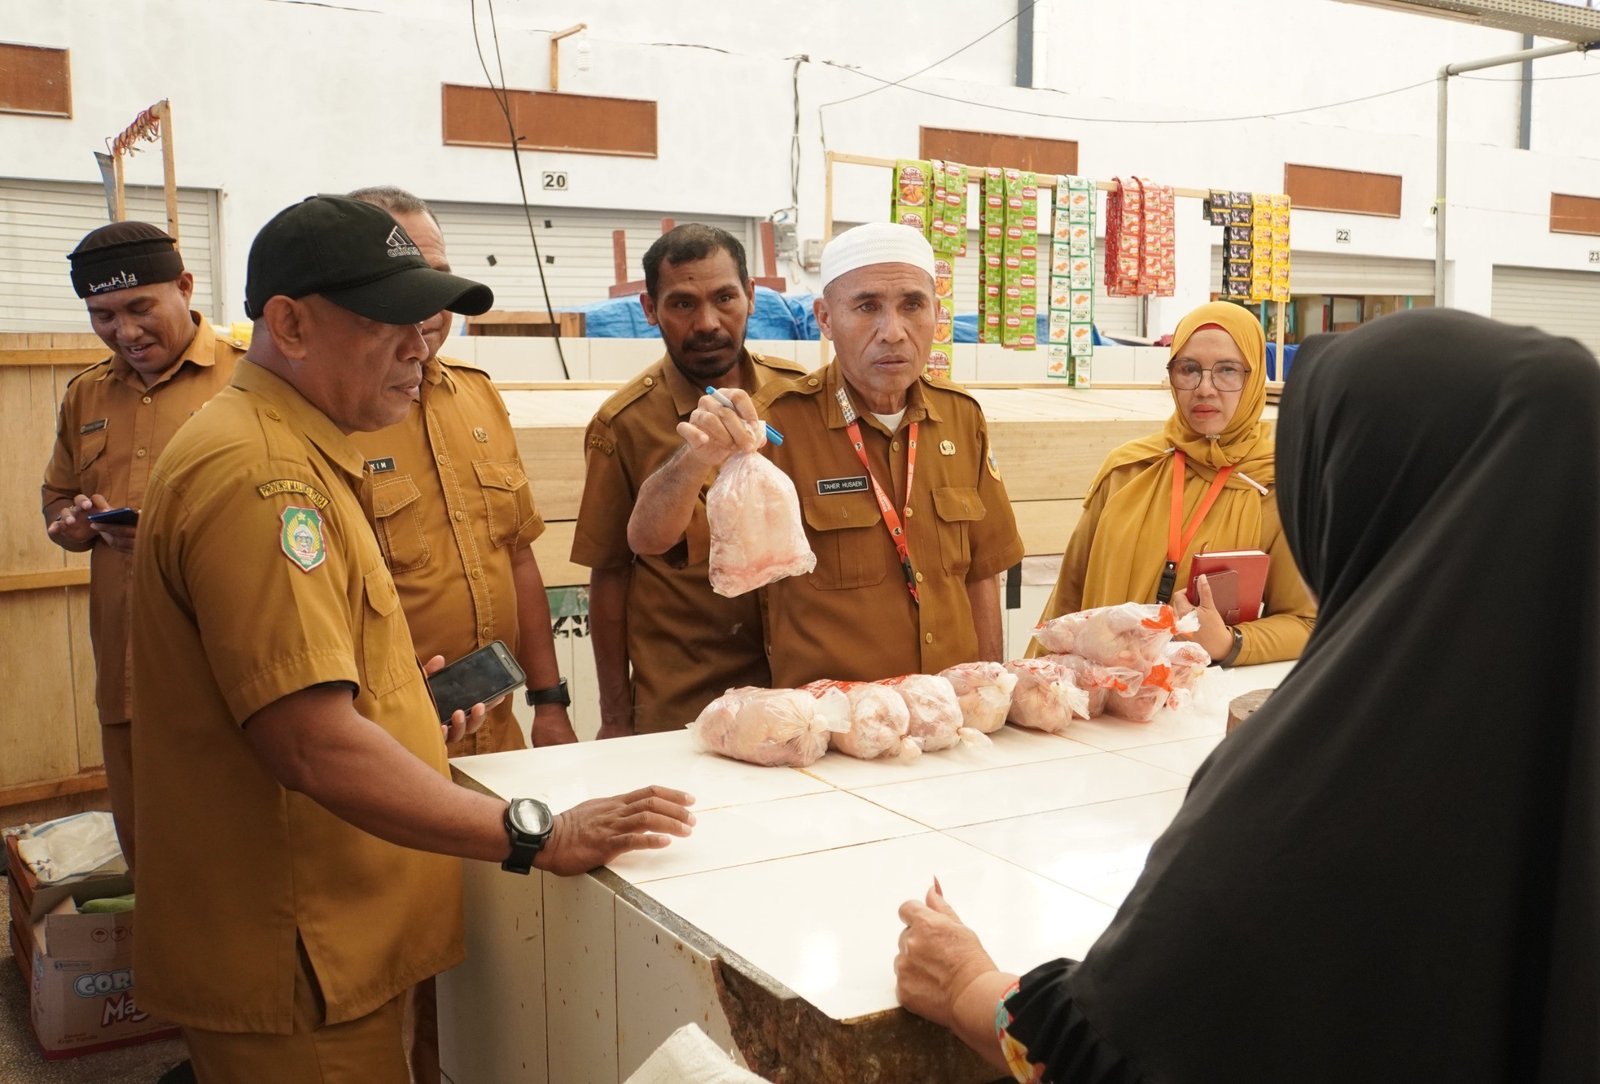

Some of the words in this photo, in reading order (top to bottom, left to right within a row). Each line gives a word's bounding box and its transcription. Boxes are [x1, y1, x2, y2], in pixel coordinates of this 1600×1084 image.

[545, 174, 566, 188] 20
[1336, 230, 1349, 241] 22
[823, 482, 840, 490] TAHER
[841, 480, 863, 489] HUSAEN
[75, 969, 134, 998] GOR
